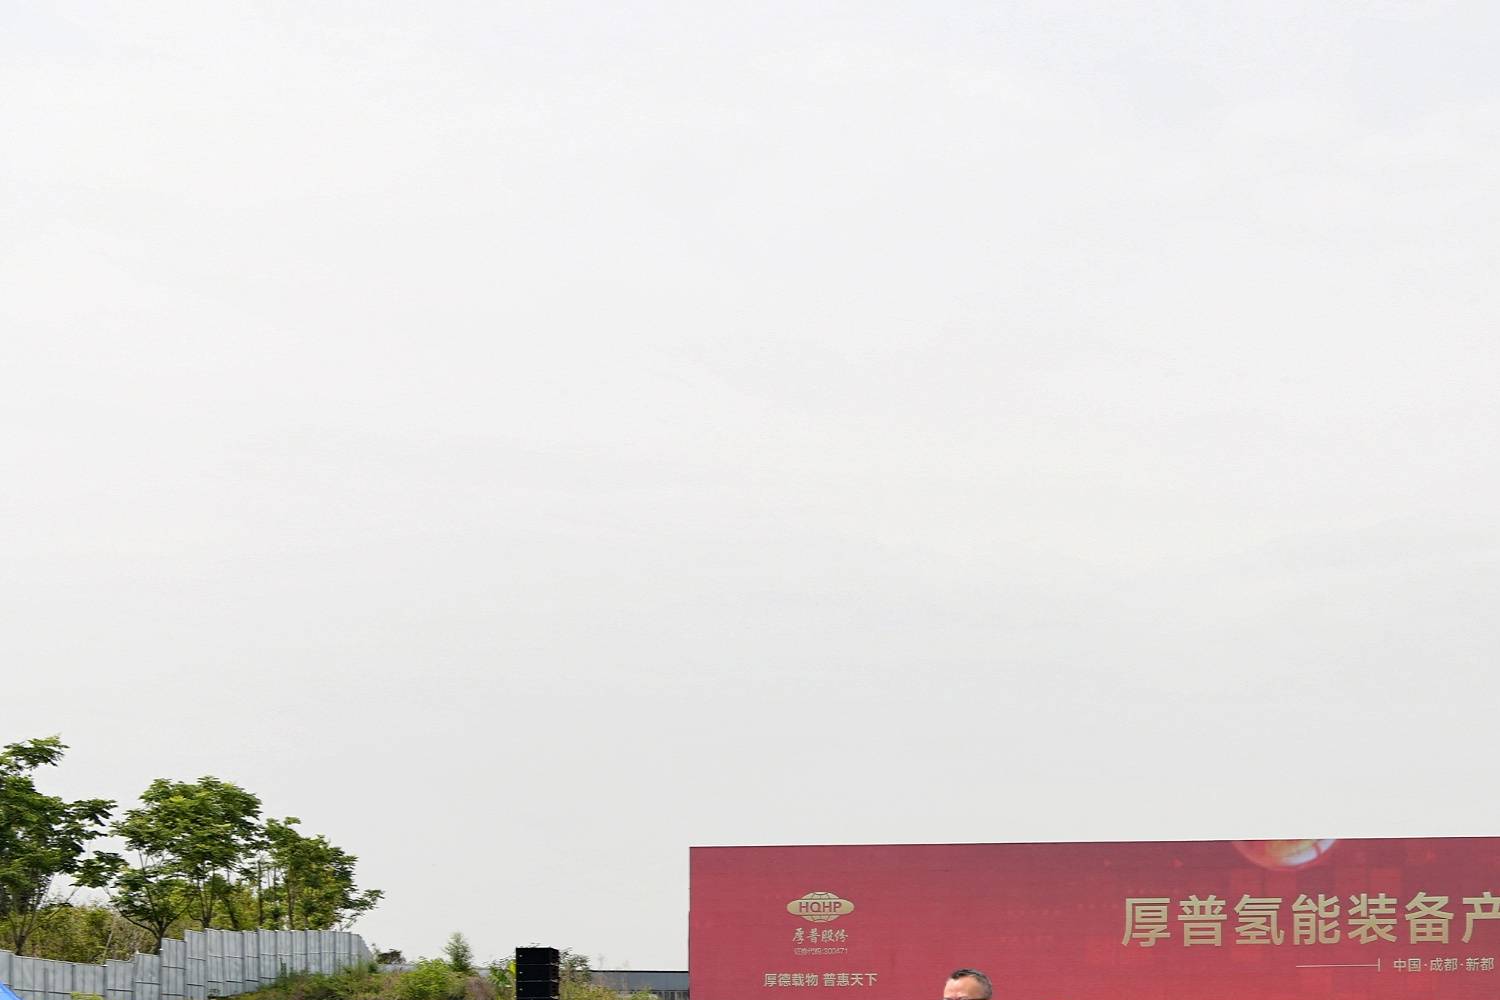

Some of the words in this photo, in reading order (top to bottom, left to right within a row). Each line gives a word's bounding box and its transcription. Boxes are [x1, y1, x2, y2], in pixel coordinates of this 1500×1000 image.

[799, 901, 842, 913] HQHP
[763, 973, 819, 988] 厚德载物
[823, 973, 879, 988] 普惠天下
